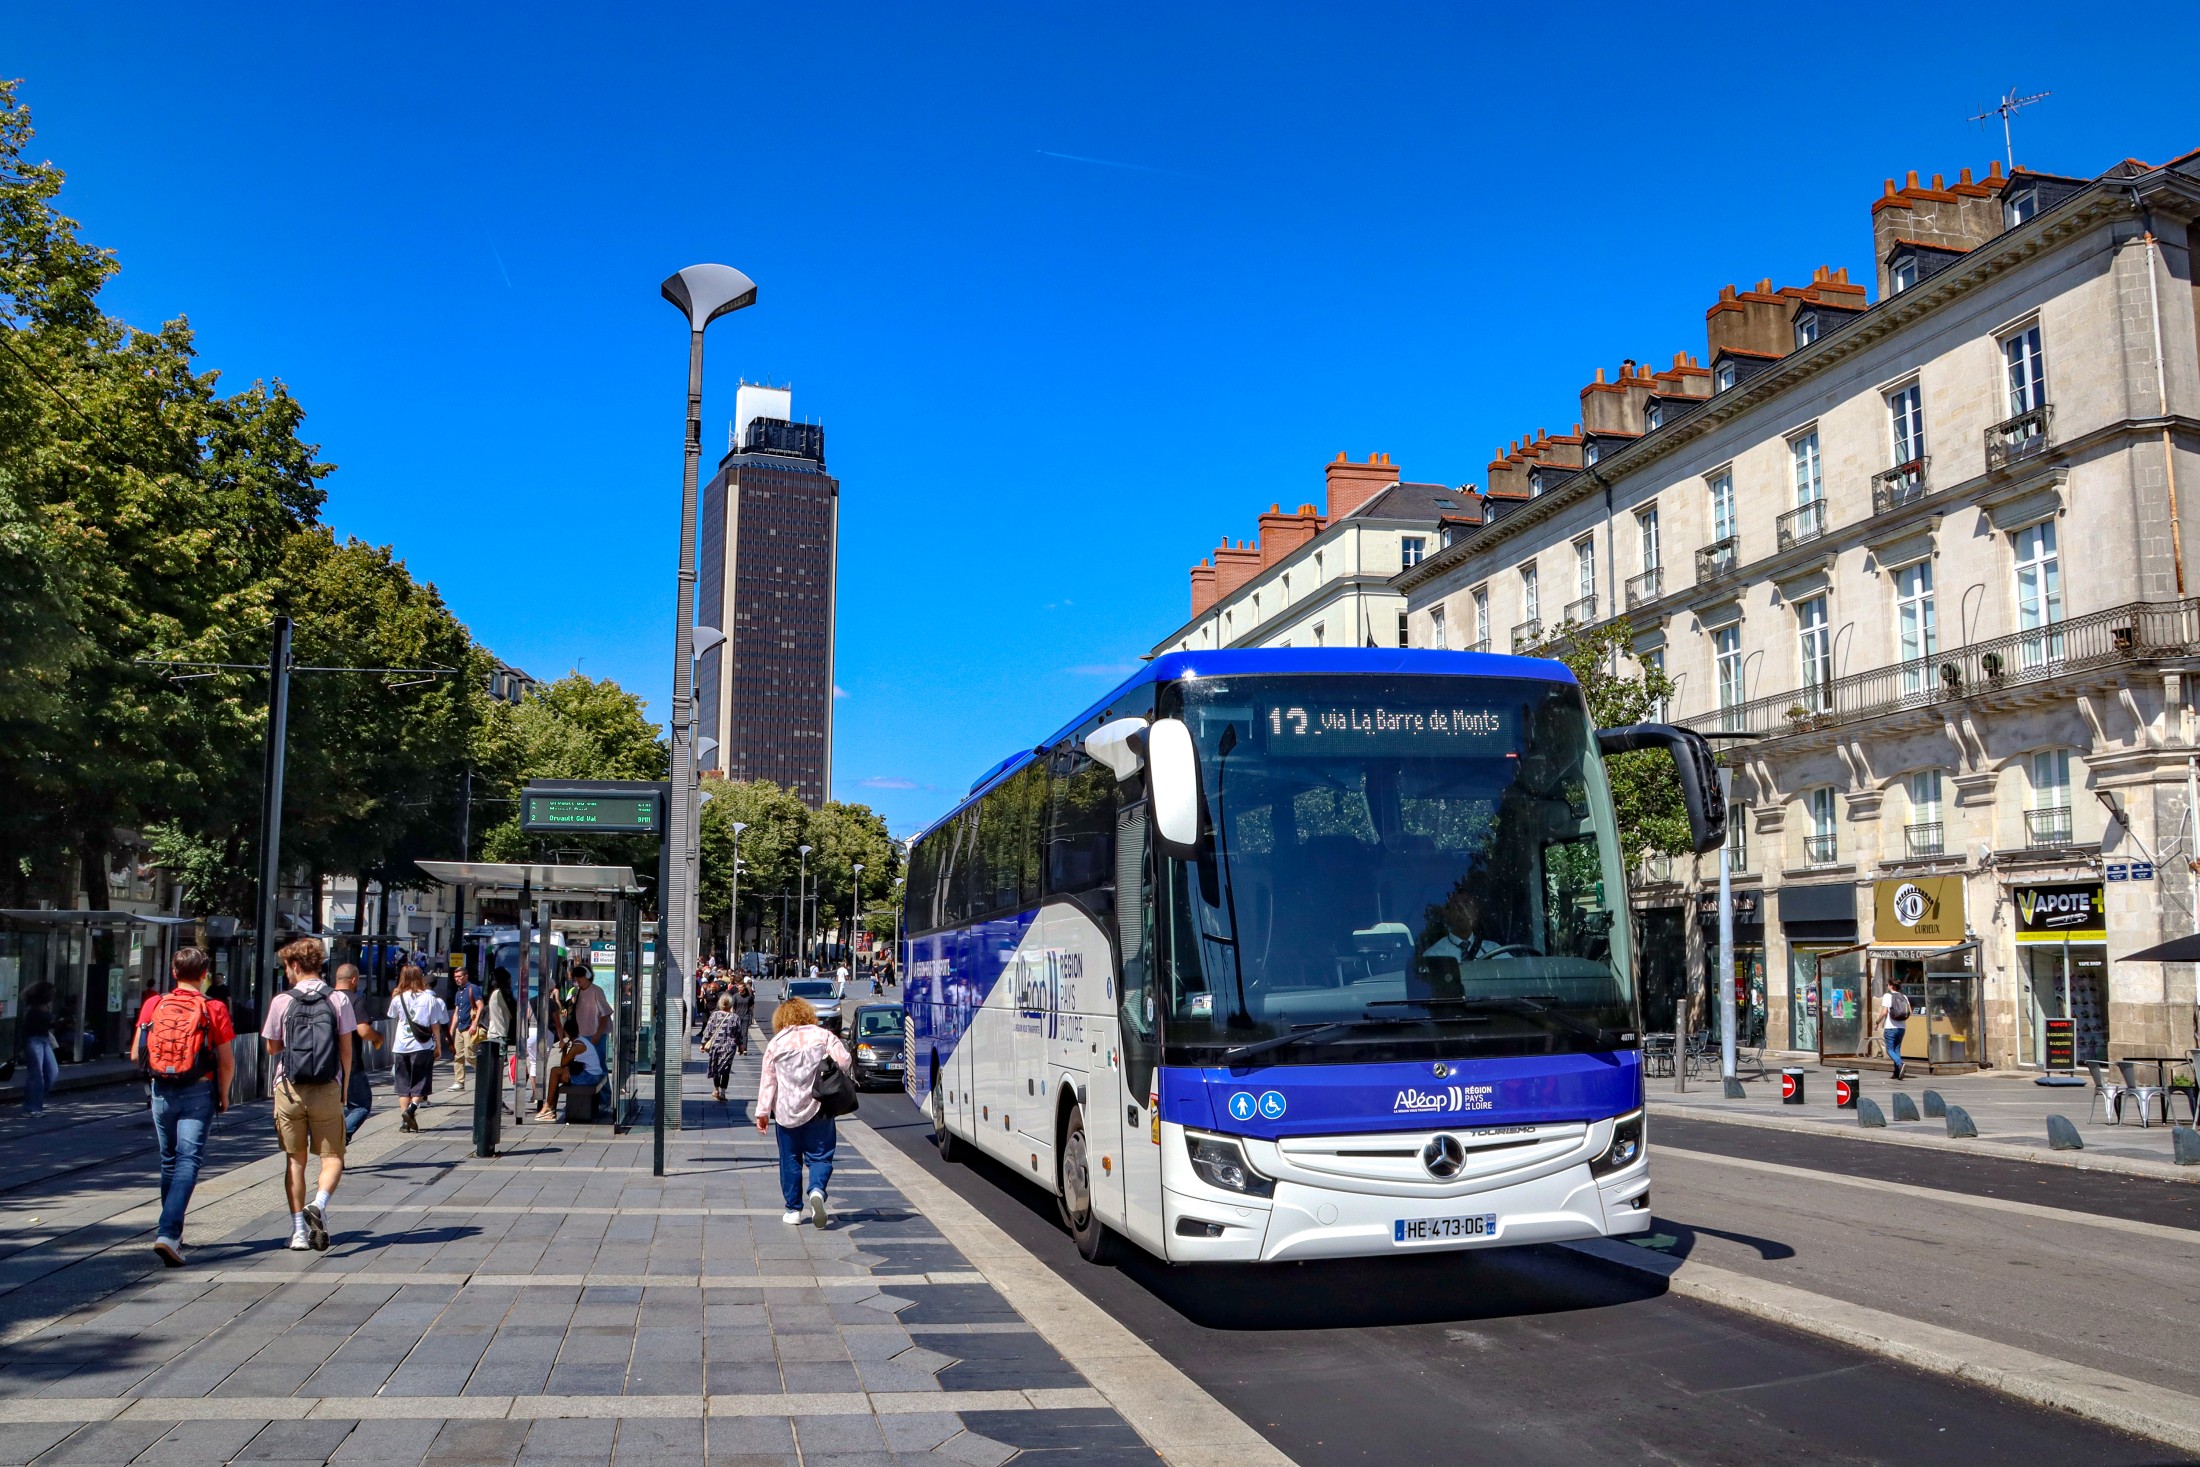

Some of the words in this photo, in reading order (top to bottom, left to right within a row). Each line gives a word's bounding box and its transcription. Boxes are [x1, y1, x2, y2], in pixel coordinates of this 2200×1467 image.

[1321, 708, 1347, 730] via
[1352, 708, 1371, 730] La
[1376, 708, 1424, 730] Barre
[1429, 709, 1448, 730] de
[1453, 709, 1500, 731] Monts
[1914, 923, 1941, 935] CURIEUX
[1060, 949, 1083, 979] RÉGION
[1060, 984, 1076, 1011] PAYS
[1066, 1016, 1084, 1043] LOIRE
[1393, 1088, 1448, 1113] Aléop
[1464, 1086, 1493, 1095] RÉGION
[1464, 1094, 1484, 1102] PAYS
[1471, 1101, 1493, 1111] LOIRE
[1470, 1126, 1536, 1137] TOURISMO
[1407, 1217, 1484, 1239] HE-473-DG
[1487, 1224, 1496, 1233] 44
